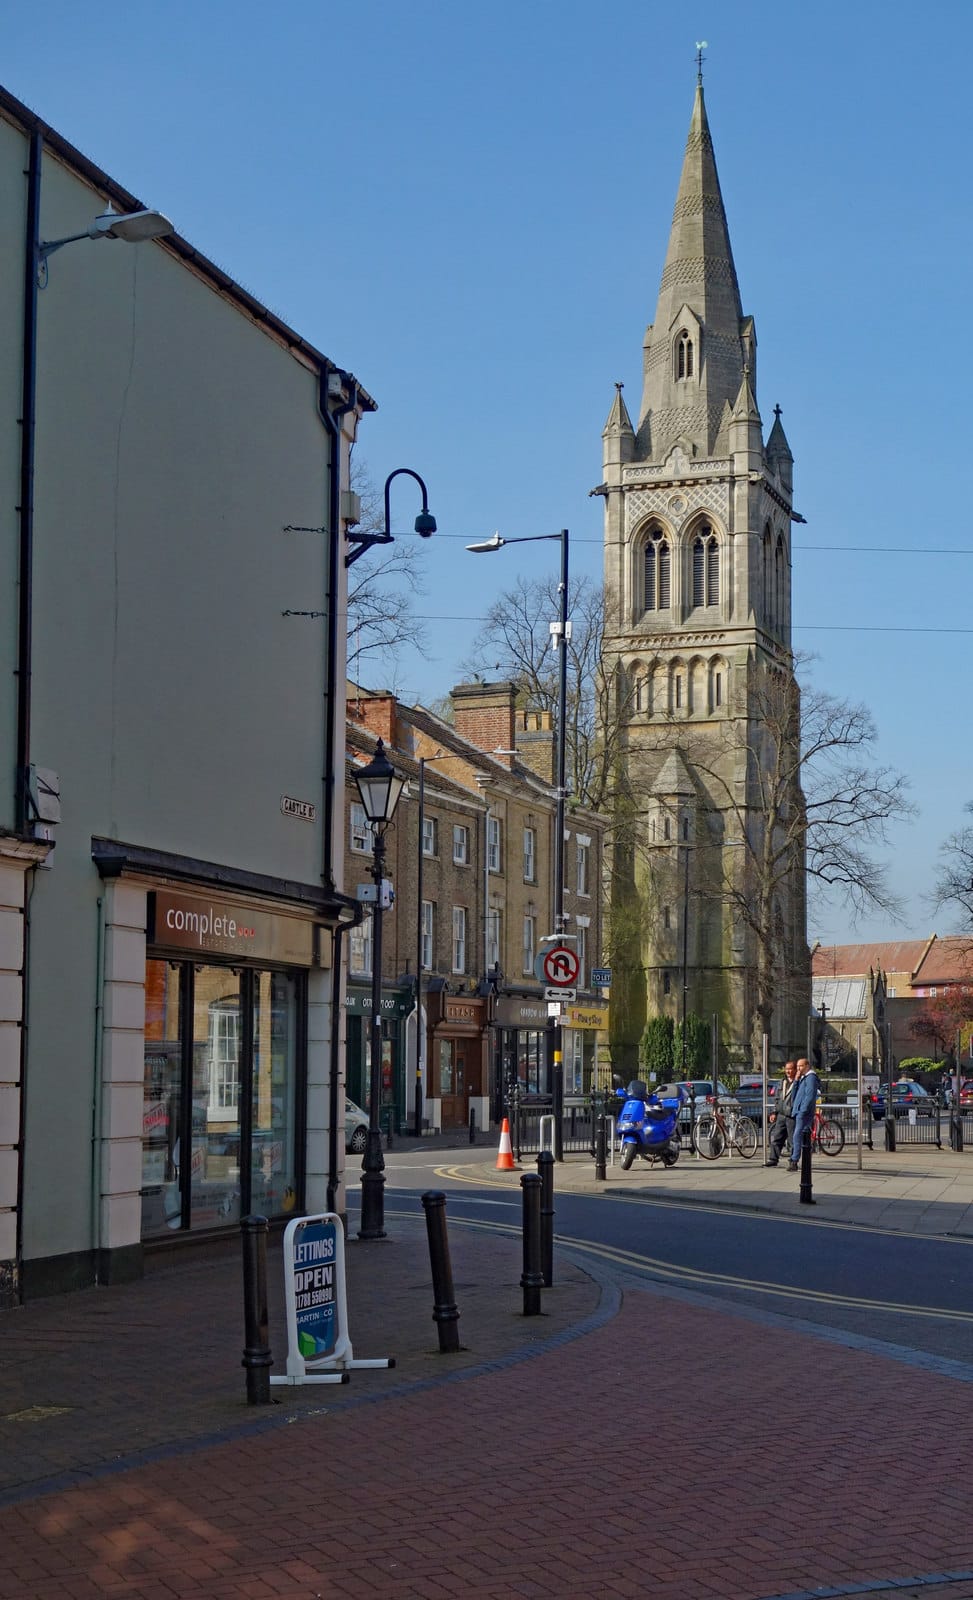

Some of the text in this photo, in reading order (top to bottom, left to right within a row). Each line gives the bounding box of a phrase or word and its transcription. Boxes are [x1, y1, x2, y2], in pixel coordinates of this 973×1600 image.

[284, 799, 307, 816] CASTLE
[166, 907, 237, 945] complete
[294, 1238, 334, 1264] LETTINGS
[295, 1266, 333, 1293] OPEN
